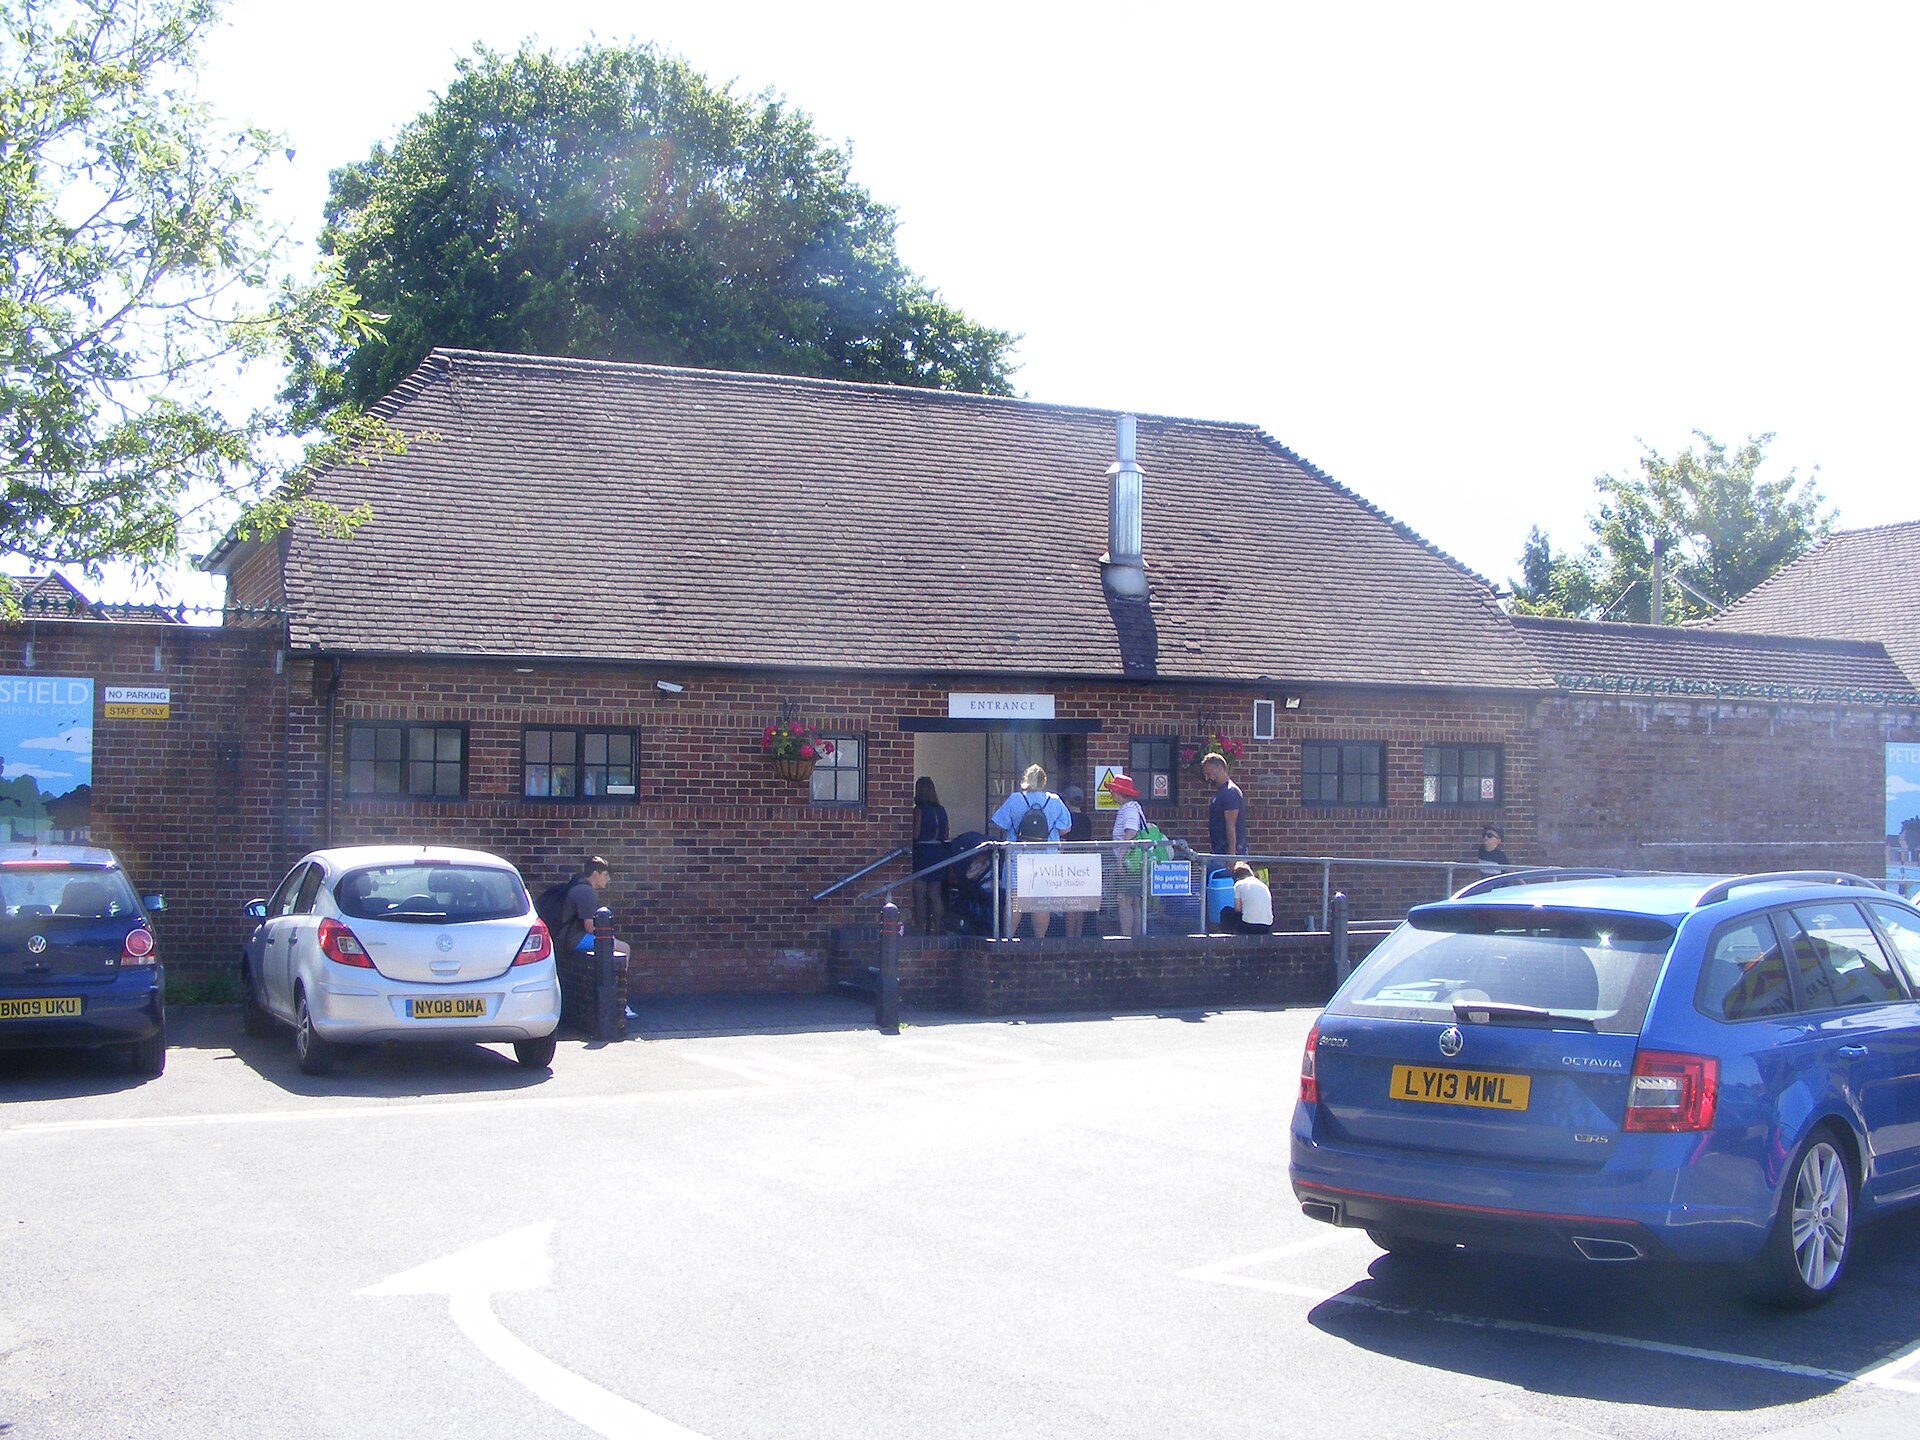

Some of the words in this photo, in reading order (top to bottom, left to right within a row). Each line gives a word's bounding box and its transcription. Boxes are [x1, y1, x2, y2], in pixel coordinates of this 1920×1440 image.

[108, 690, 123, 699] NO
[126, 691, 167, 700] PARKING
[970, 700, 1035, 710] ENTRANCE
[51, 706, 88, 718] POOL
[109, 706, 138, 716] STAFF
[140, 707, 165, 716] ONLY
[1039, 864, 1064, 878] Wild
[1067, 865, 1090, 877] Nest
[1045, 879, 1062, 889] Yoga
[1063, 879, 1086, 887] Studio
[1165, 874, 1188, 883] parking
[1161, 882, 1173, 890] this
[0, 1001, 41, 1016] BN09
[45, 1000, 76, 1014] UKU
[415, 1000, 453, 1014] NY08
[456, 999, 484, 1013] OMA
[1562, 1056, 1622, 1068] OCTAVIA
[1405, 1070, 1459, 1099] LY13
[1464, 1075, 1513, 1105] MWL
